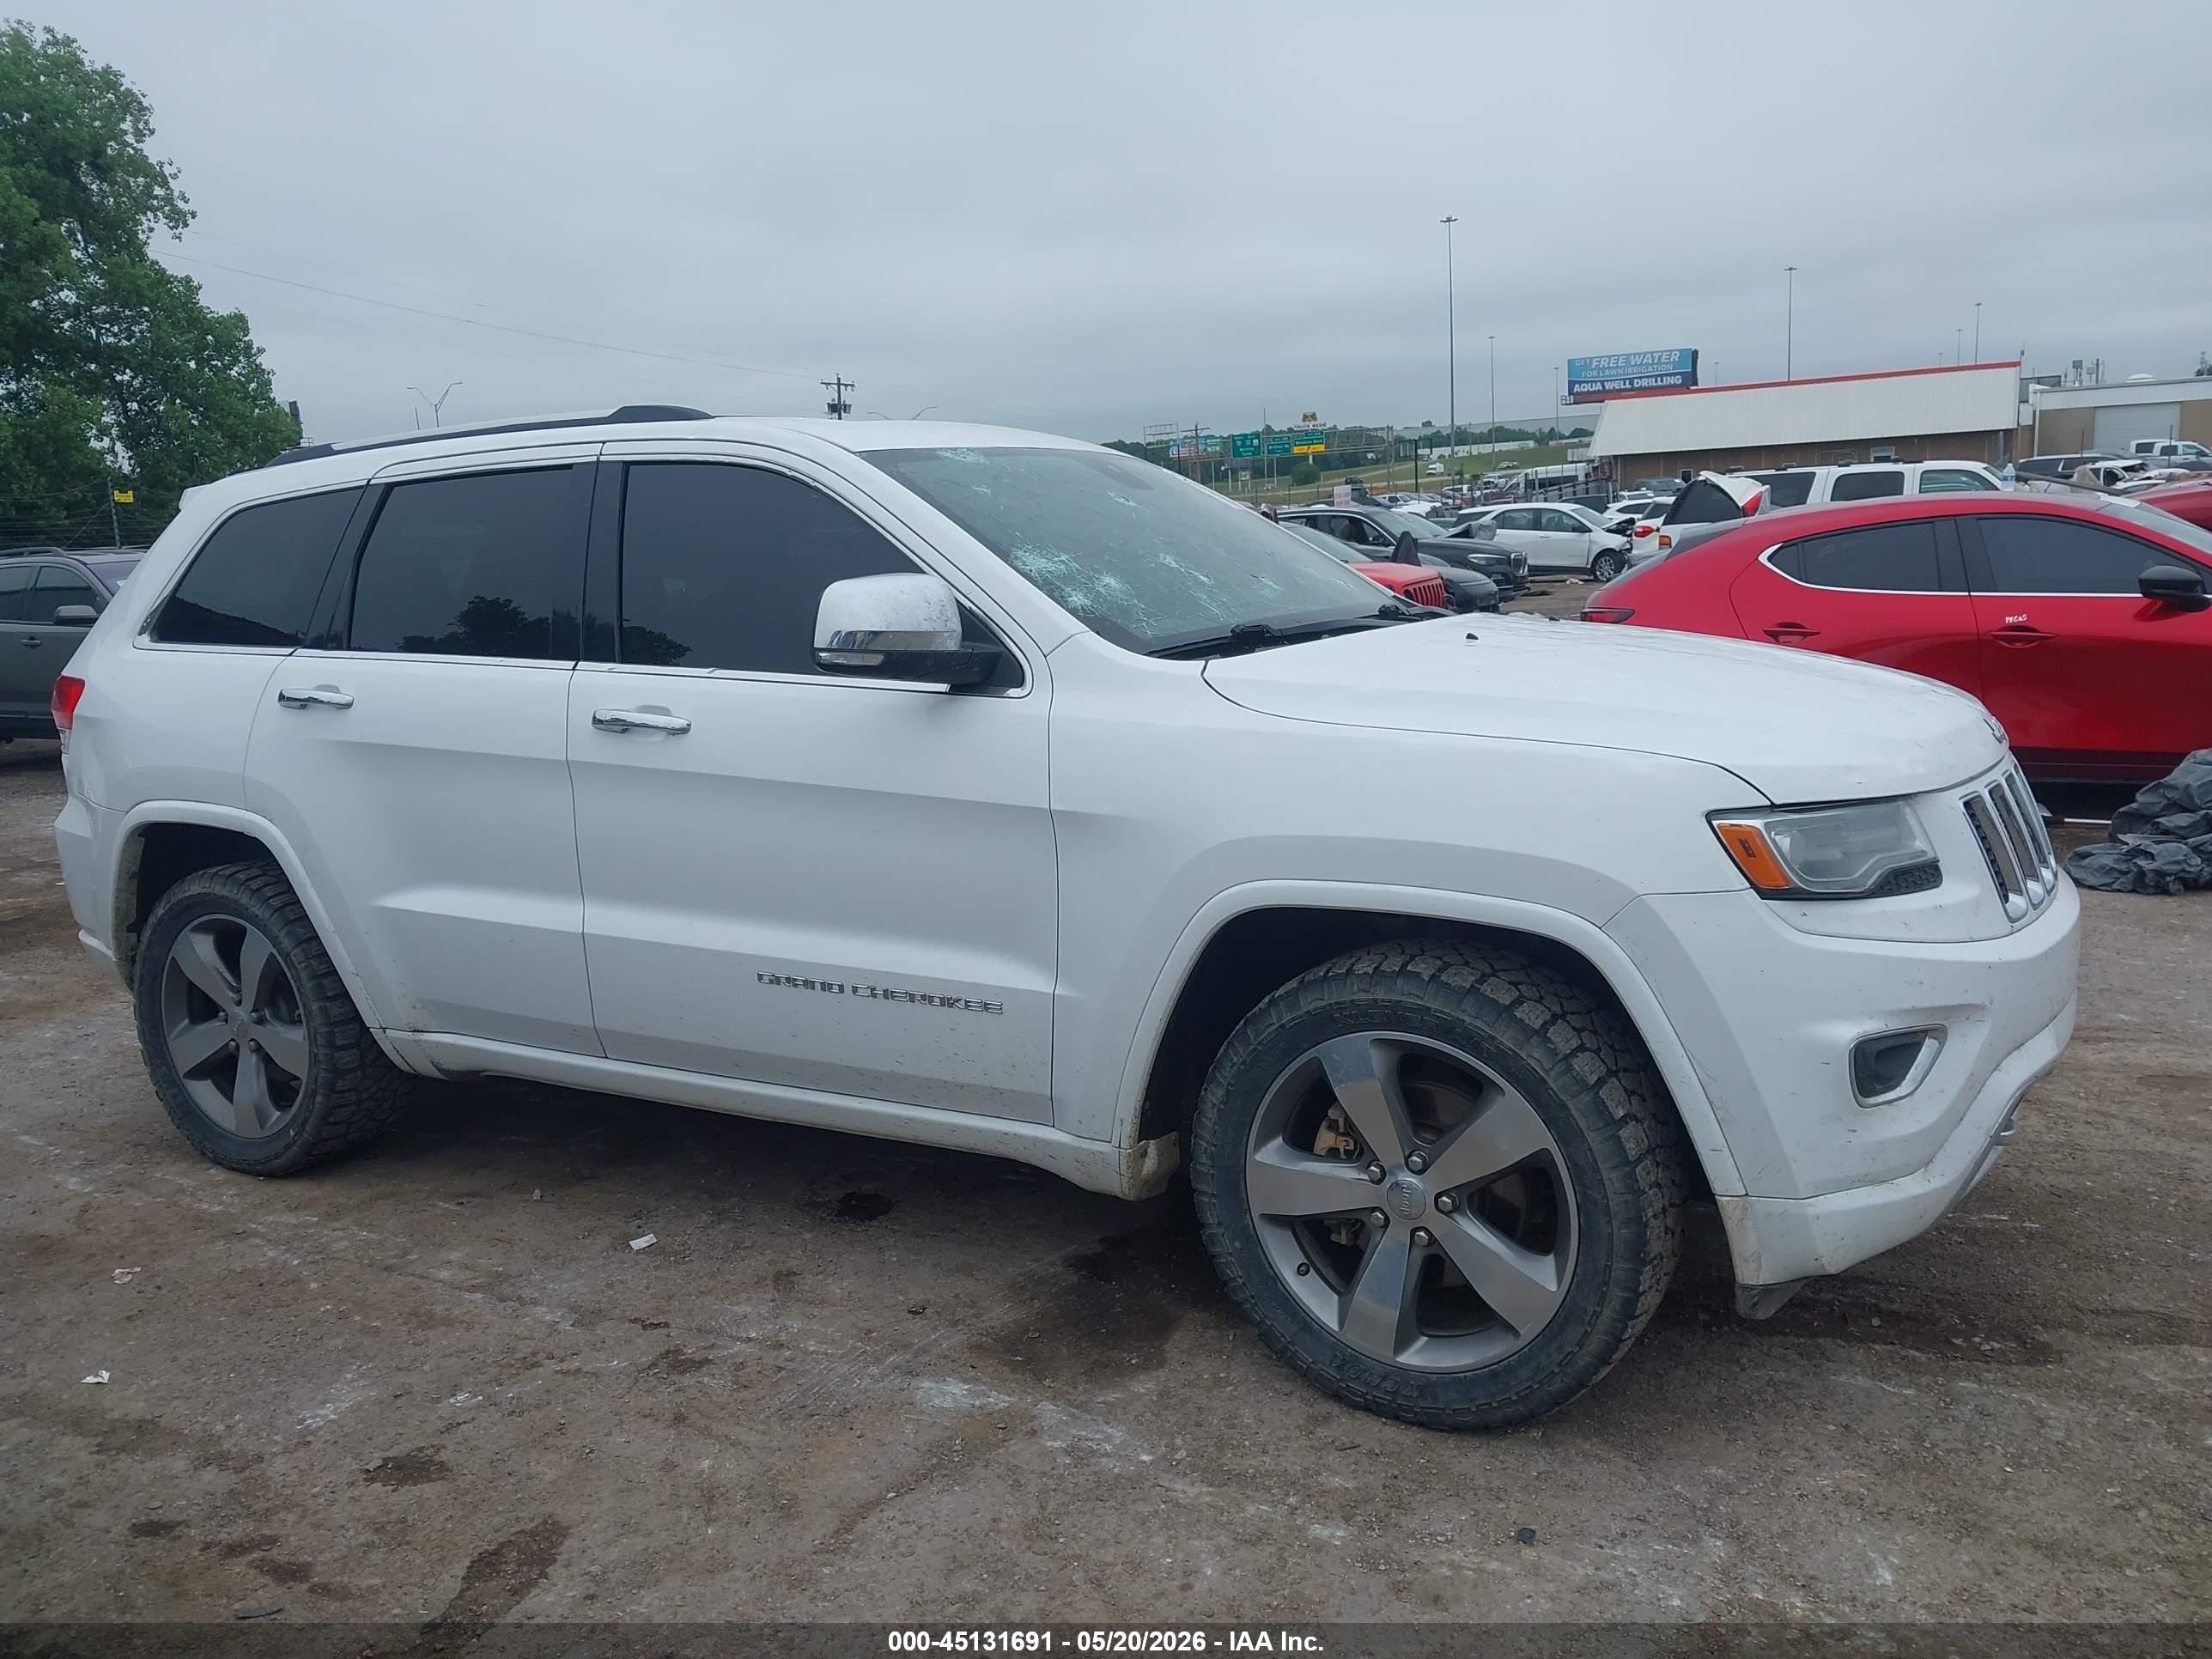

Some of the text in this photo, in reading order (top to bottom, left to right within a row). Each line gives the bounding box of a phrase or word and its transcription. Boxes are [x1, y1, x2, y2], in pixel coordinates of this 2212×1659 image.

[1591, 356, 1626, 368] FREE
[1631, 350, 1680, 366] WATER
[1599, 368, 1625, 377] LAWN
[1626, 363, 1674, 374] IRRIGATION
[1573, 375, 1682, 393] AQUA WELL DRILLING
[756, 970, 1004, 1015] GRAND CHEROKEE
[1401, 1184, 1413, 1215] Jeep
